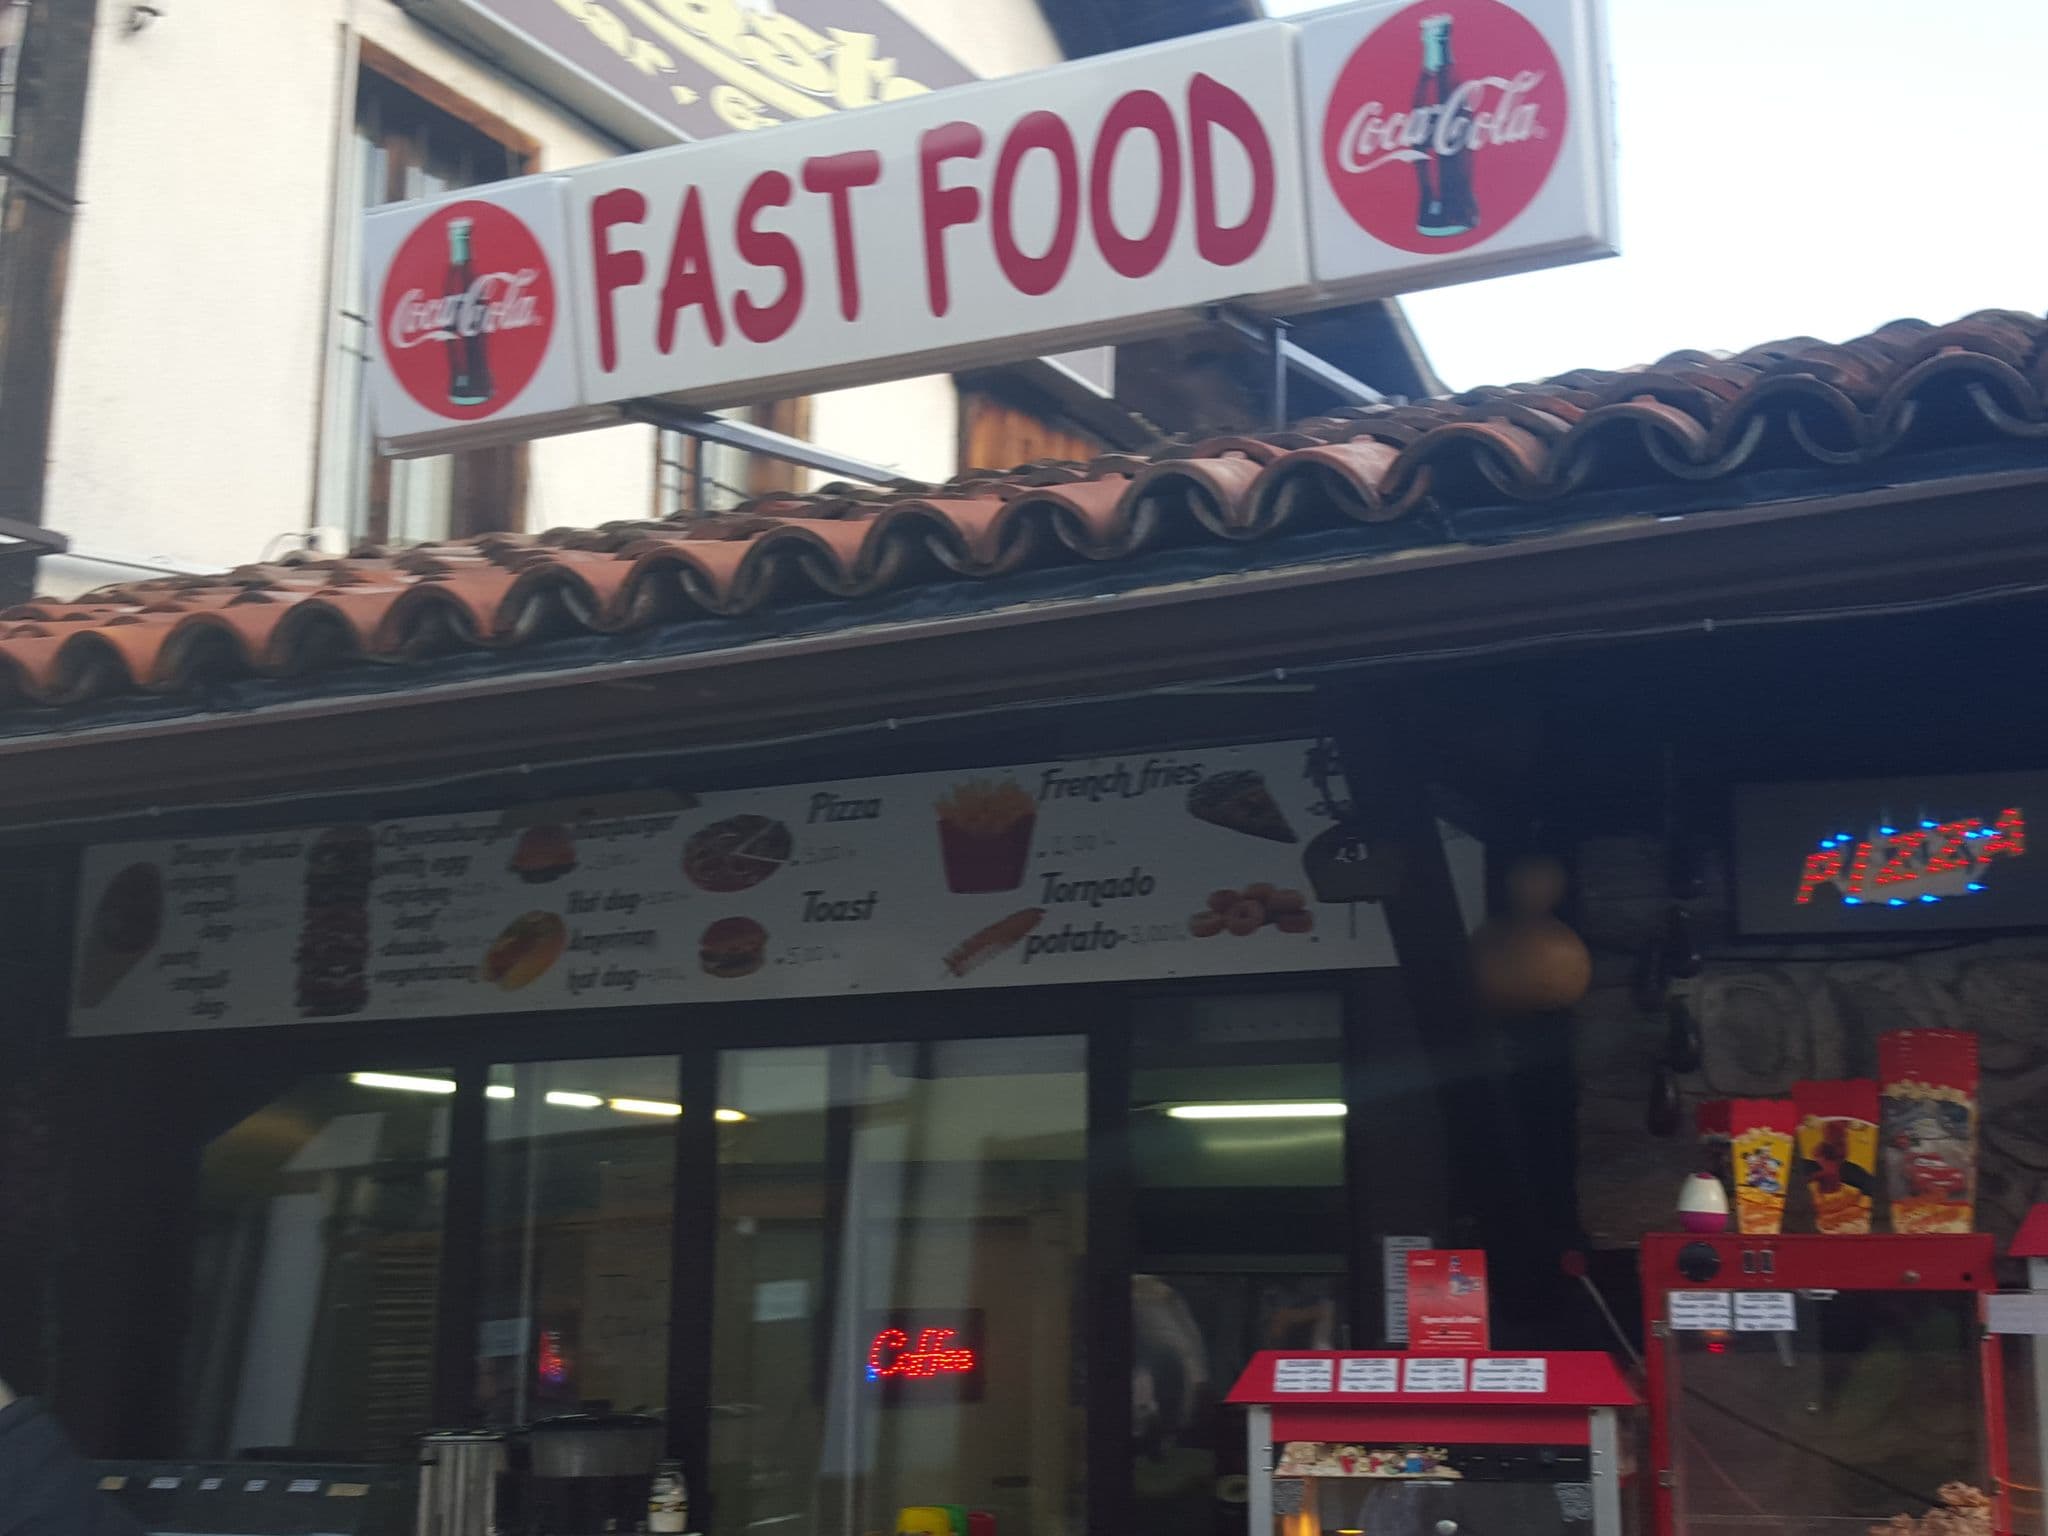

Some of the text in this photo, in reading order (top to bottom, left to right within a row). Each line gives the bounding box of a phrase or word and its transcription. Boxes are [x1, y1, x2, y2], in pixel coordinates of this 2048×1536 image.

[590, 73, 1276, 374] FAST FOOD
[1039, 758, 1203, 802] French fries
[805, 791, 883, 824] Pizza
[1796, 807, 2026, 904] PIZZA
[801, 890, 880, 923] Toast
[1040, 866, 1156, 908] Tornado
